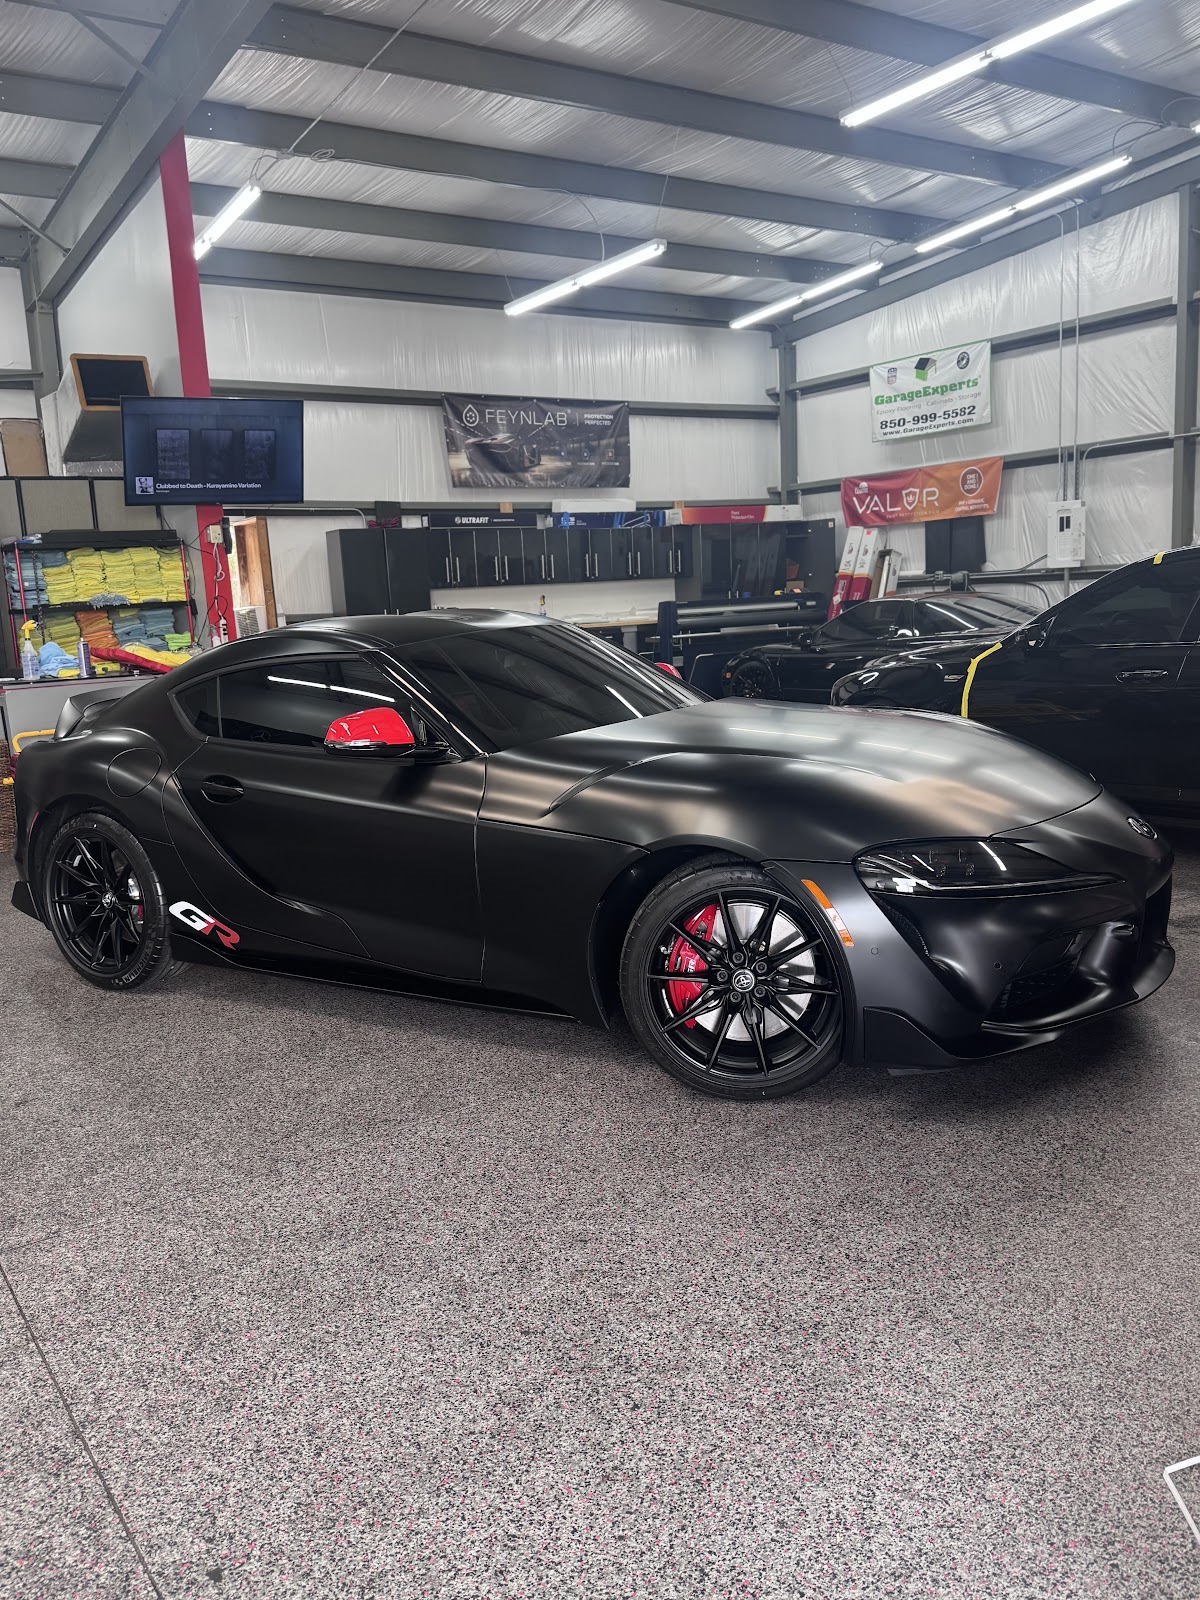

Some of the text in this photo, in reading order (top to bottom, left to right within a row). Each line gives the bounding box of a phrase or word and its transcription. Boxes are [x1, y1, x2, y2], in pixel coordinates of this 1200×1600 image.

[874, 377, 979, 406] GarageExperts
[876, 391, 982, 416] Epoxy Flooring Cabinets Storage
[485, 409, 568, 426] FEYNLAB
[880, 405, 976, 430] 850-999-5582
[882, 417, 974, 436] www.GarageExperts.com
[852, 487, 940, 515] VALOR
[461, 516, 490, 524] ULTRAFIT
[168, 900, 241, 951] GR
[123, 949, 151, 983] MICHELIN
